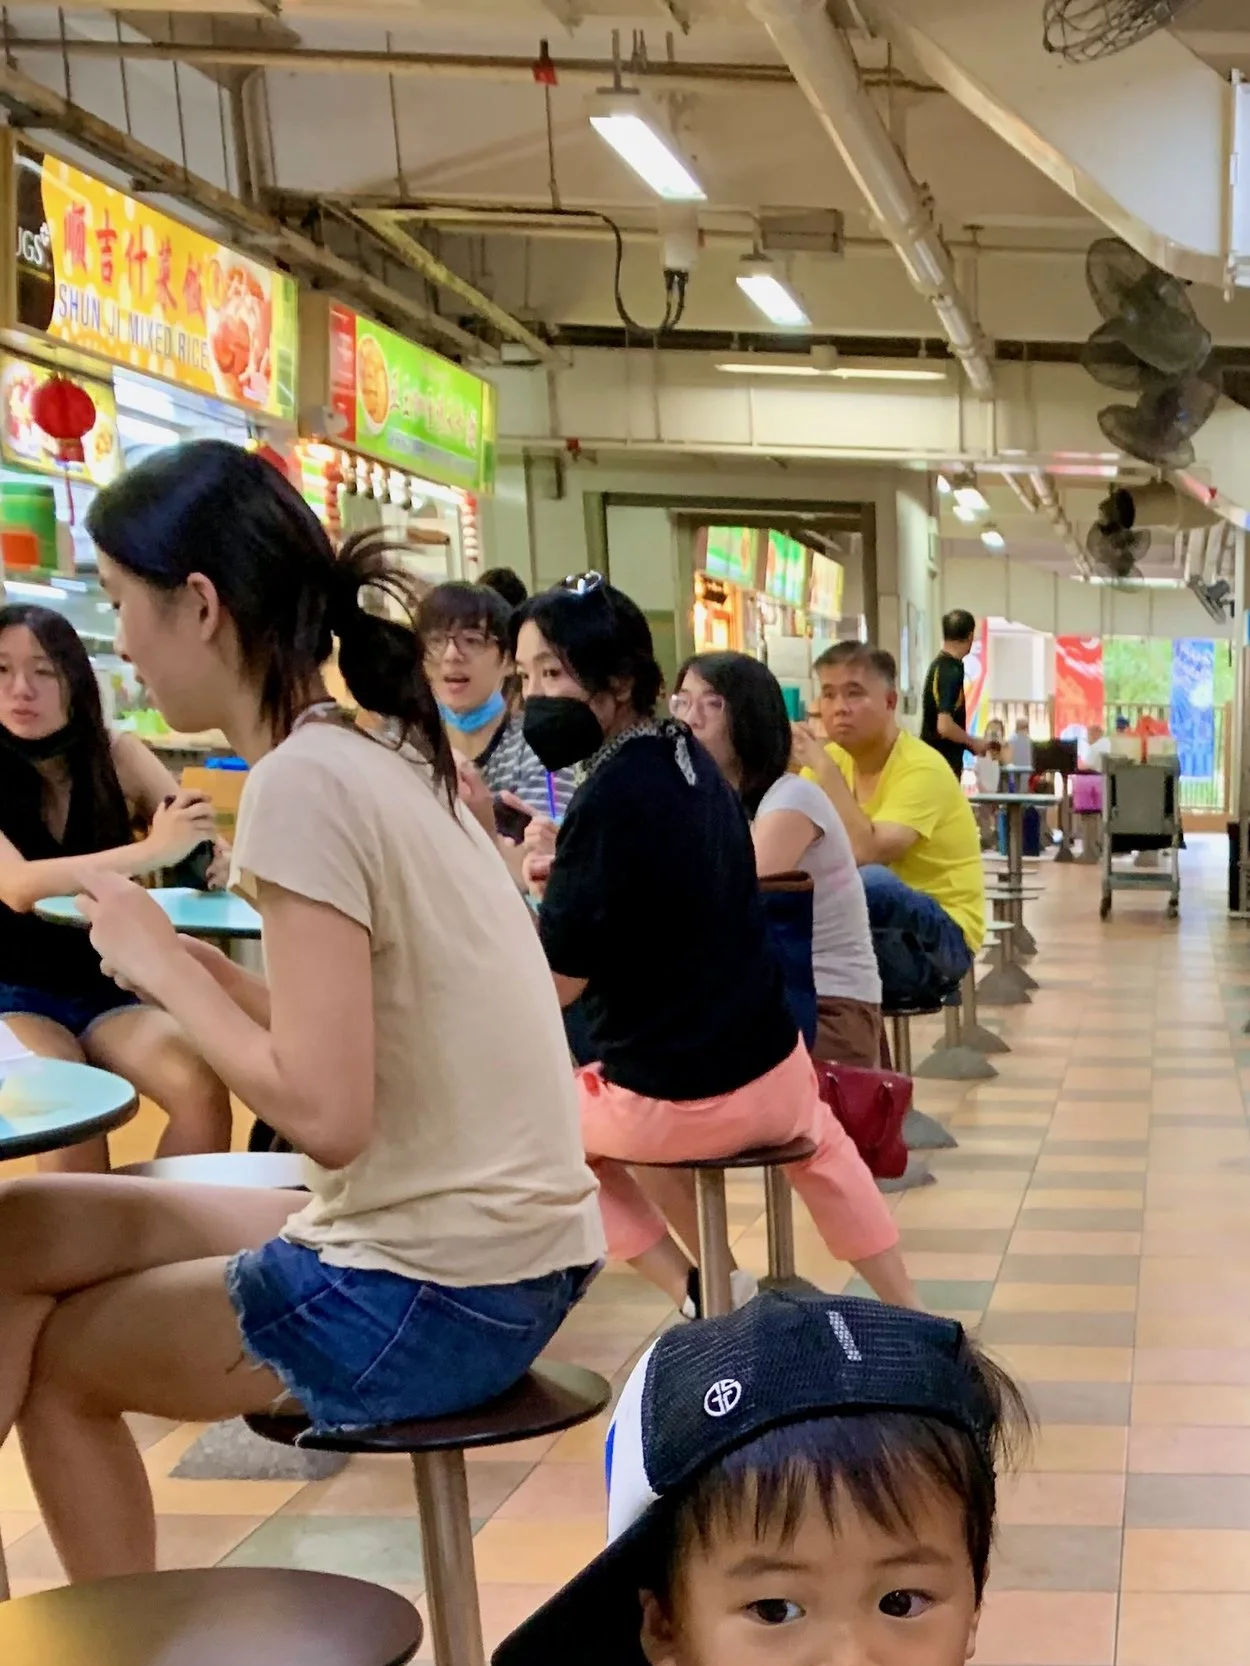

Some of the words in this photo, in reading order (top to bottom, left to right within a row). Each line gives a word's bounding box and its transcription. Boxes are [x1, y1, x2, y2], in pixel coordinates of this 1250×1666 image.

[59, 284, 100, 331] SHUN
[108, 306, 121, 338] JI
[128, 312, 173, 357] MIXED
[178, 332, 208, 372] RICE
